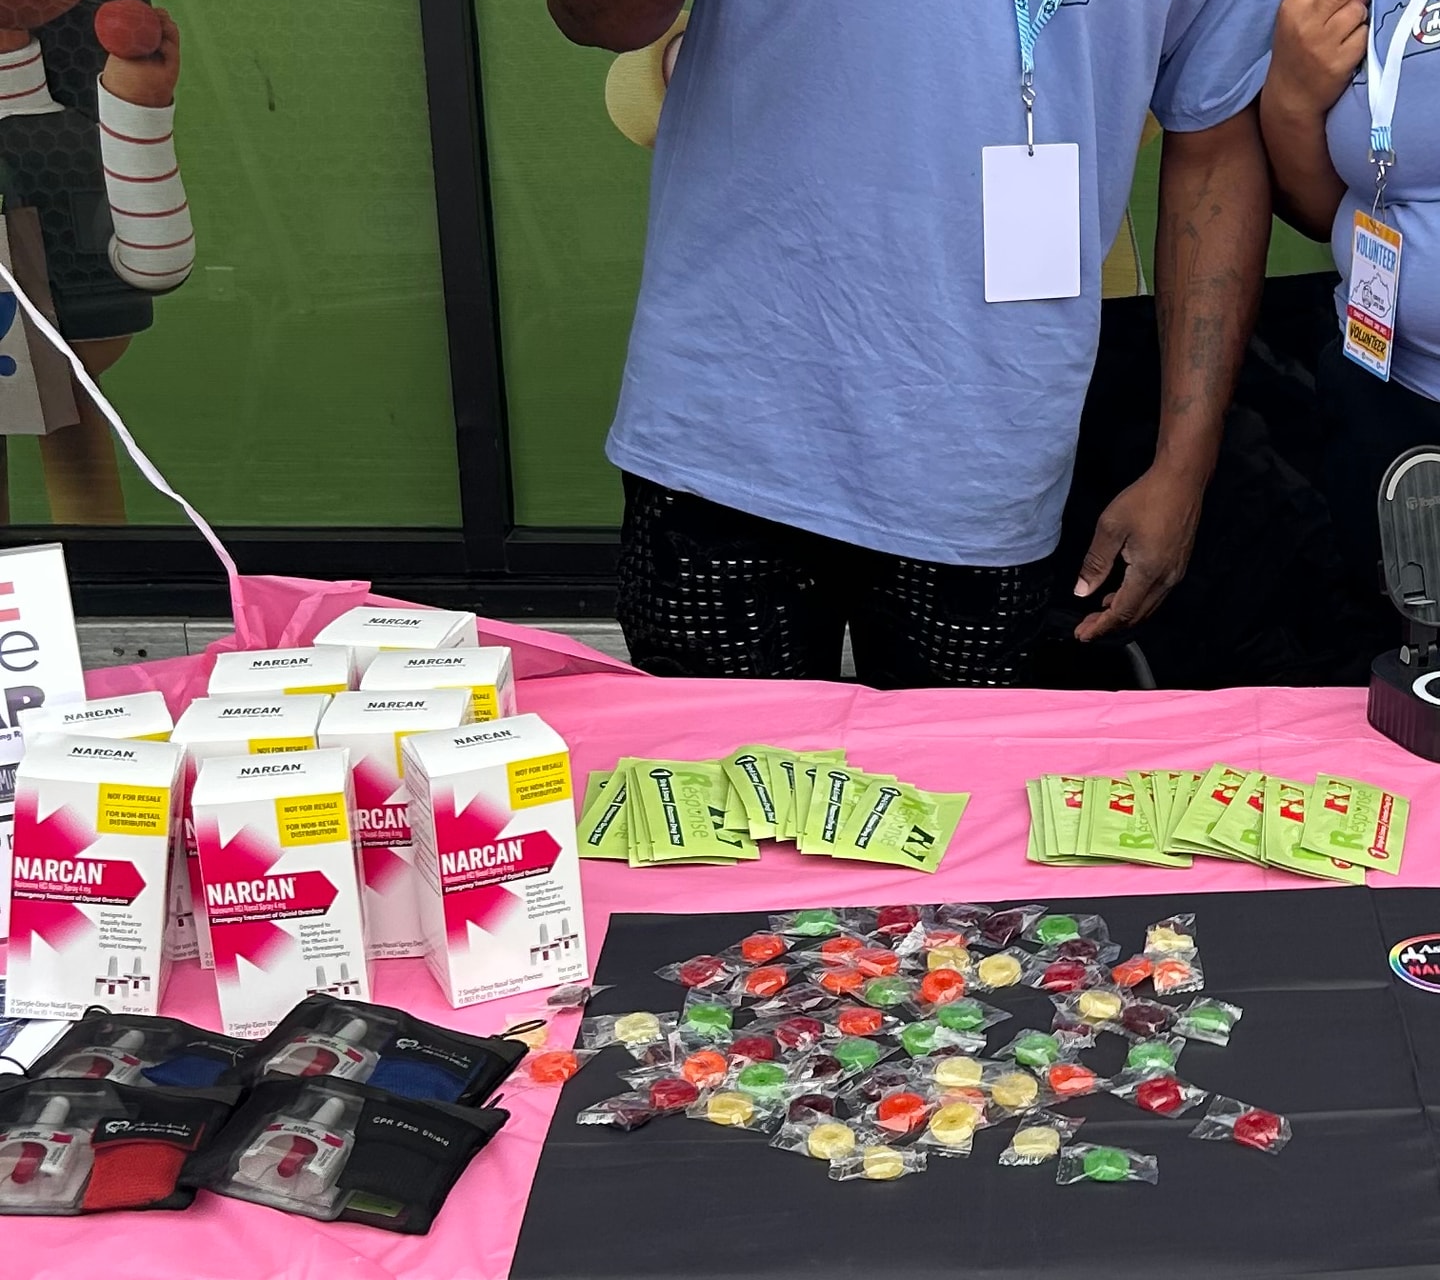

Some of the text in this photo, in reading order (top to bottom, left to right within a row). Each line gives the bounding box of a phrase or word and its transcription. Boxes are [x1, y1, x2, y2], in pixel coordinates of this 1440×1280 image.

[1356, 231, 1396, 273] VOLUNTEER
[1350, 322, 1387, 355] VOLUNTEER
[368, 617, 422, 626] NARCAN
[253, 657, 310, 667] NARCAN
[408, 657, 464, 666] NARCAN
[367, 701, 426, 709] NARCAN
[64, 707, 124, 721] NARCAN
[222, 707, 282, 716] NARCAN
[453, 730, 512, 745] NARCAN
[72, 747, 135, 758] NARCAN
[240, 763, 302, 775] NARCAN
[442, 842, 523, 876] NARCAN
[14, 856, 104, 885] NARCAN
[14, 891, 45, 900] Emergency
[206, 877, 295, 906] NARCAN
[373, 1116, 394, 1125] CPR
